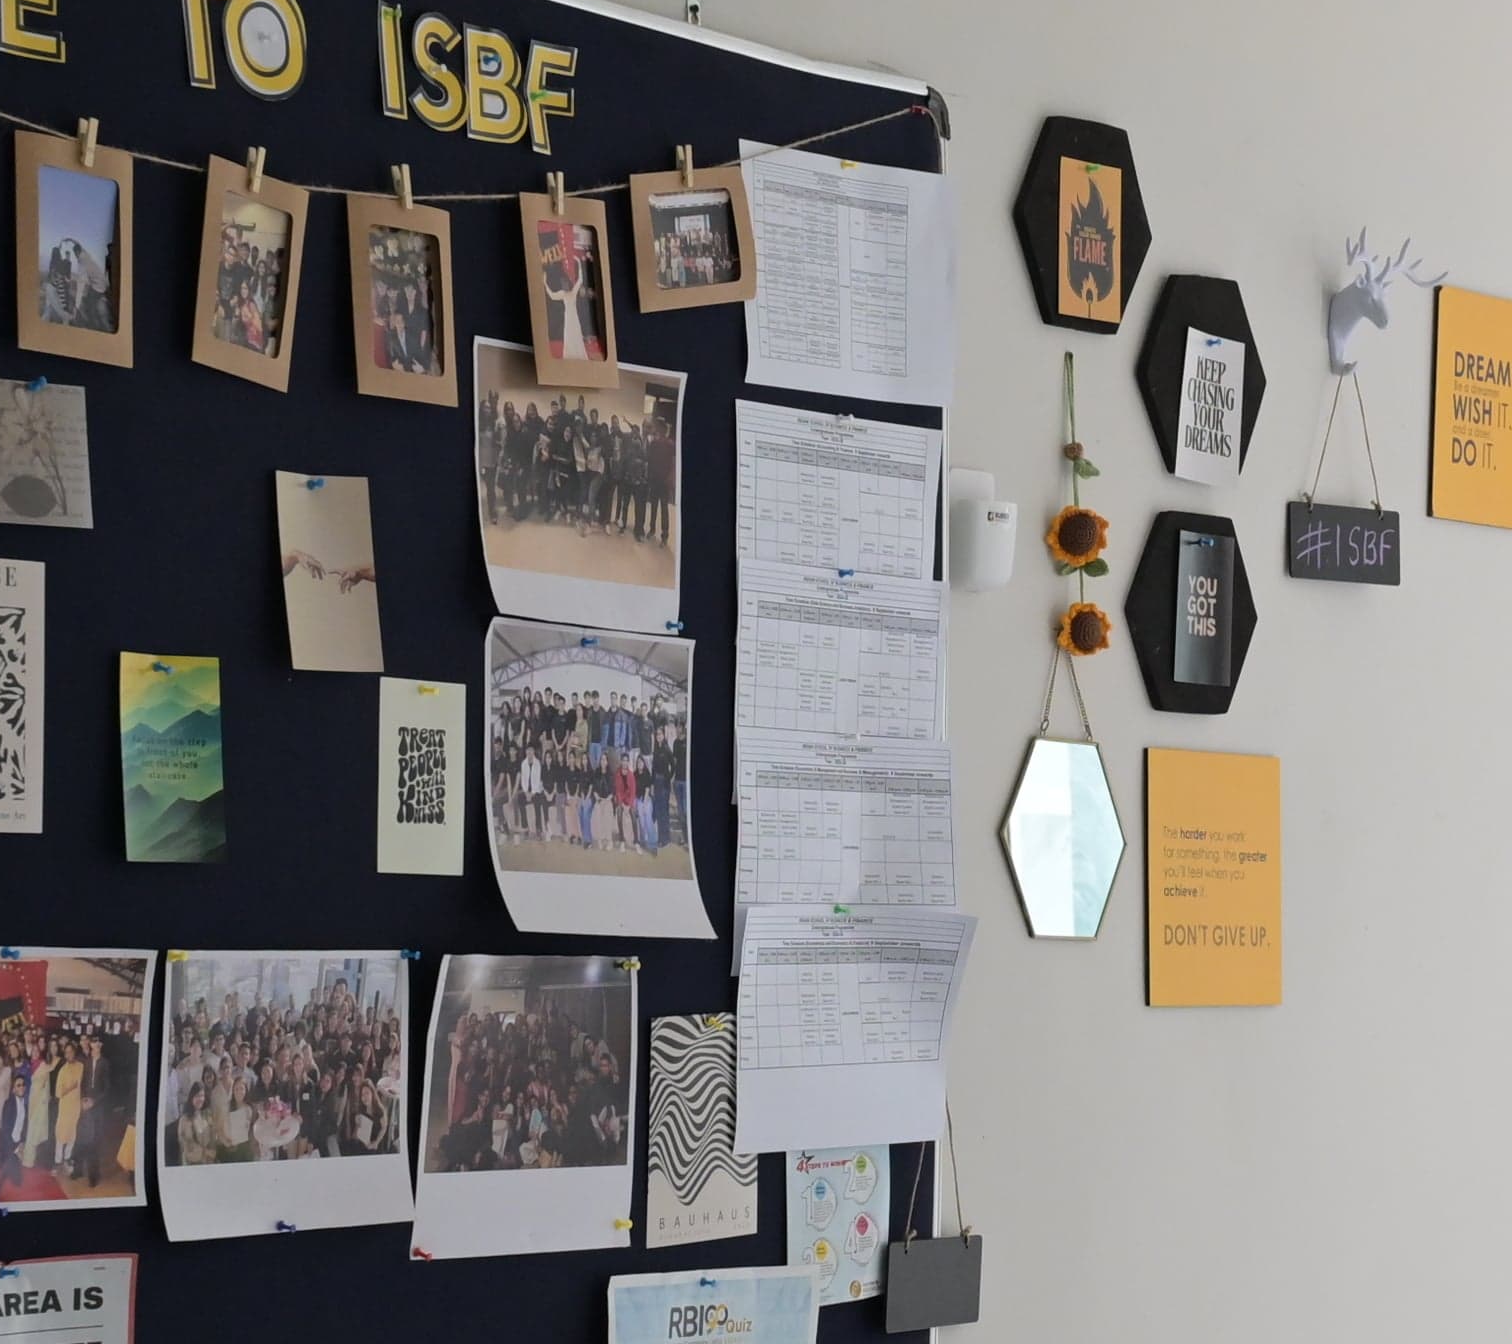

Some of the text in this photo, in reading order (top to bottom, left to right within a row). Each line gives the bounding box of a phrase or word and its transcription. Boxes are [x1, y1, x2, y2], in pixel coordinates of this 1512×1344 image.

[378, 0, 578, 154] ISBF
[1073, 236, 1107, 266] FLAME
[1196, 355, 1226, 384] KEEP
[1454, 351, 1511, 387] DREAM
[1187, 377, 1235, 412] CHASING
[1193, 402, 1224, 433] YOUR
[1453, 393, 1512, 430] WISH IT.
[1184, 424, 1232, 458] DREAMS
[1451, 437, 1496, 471] DO IT.
[1296, 524, 1395, 569] #ISBF
[1188, 575, 1218, 596] YOU
[1188, 595, 1217, 616] GOT
[1187, 615, 1217, 637] THIS
[1180, 828, 1207, 840] harder
[1238, 849, 1267, 864] greater
[1163, 884, 1198, 897] achieve
[1164, 924, 1271, 947] DON'T GIVE UP.
[659, 1206, 750, 1230] BAUHAUS
[73, 1286, 104, 1311] IS
[726, 1317, 753, 1334] Quiz
